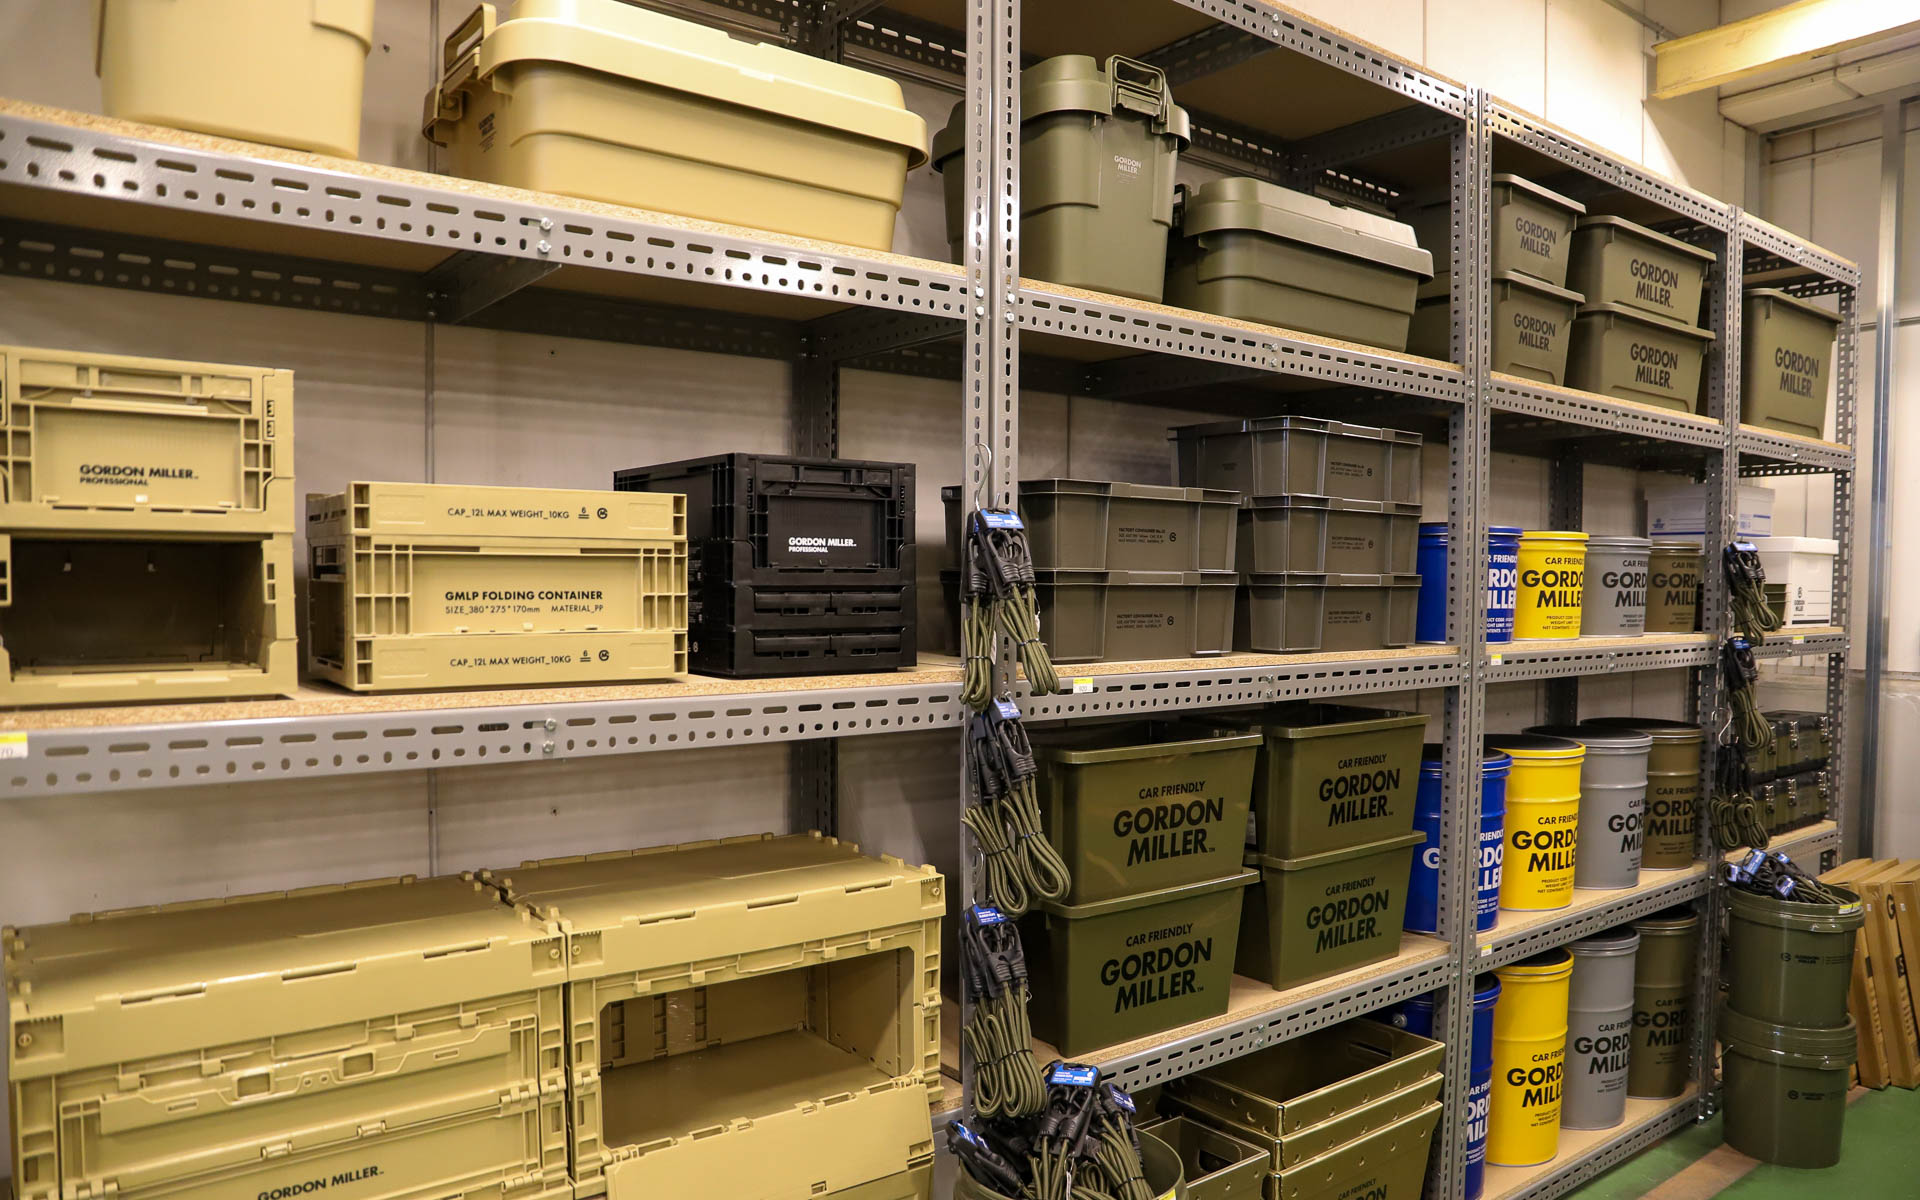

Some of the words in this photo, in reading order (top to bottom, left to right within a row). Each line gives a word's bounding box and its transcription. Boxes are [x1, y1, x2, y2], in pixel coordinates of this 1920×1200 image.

[1114, 155, 1141, 168] GORDON
[1118, 163, 1138, 174] MILLER
[1515, 216, 1557, 245] GORDON
[1520, 235, 1550, 259] MILLER
[1630, 258, 1679, 289] GORDON
[1514, 313, 1556, 337] GORDON
[1518, 330, 1550, 351] MILLER
[1630, 342, 1678, 370] GORDON
[1775, 347, 1819, 378] GORDON
[1780, 372, 1812, 398] MILLER
[80, 464, 144, 477] GORDON
[80, 477, 148, 486] PROFESSIONAL
[448, 508, 484, 518] CAP_12L
[510, 510, 569, 519] WEIGHT_10KG
[788, 537, 826, 546] GORDON
[1545, 557, 1562, 565] CAR
[1488, 568, 1517, 588] RDO
[1522, 569, 1583, 588] GORDO
[1602, 571, 1647, 588] GORD
[1652, 573, 1697, 588] GORD
[445, 591, 479, 600] GMLP
[482, 591, 534, 600] FOLDING
[538, 591, 603, 600] CONTAINER
[1487, 590, 1516, 609] ILLE
[1537, 590, 1581, 608] MILLE
[1615, 590, 1647, 607] MILL
[1664, 590, 1695, 606] MILL
[552, 605, 604, 613] MATERIAL_PP
[450, 658, 486, 668] CAP_12L
[490, 657, 509, 665] MAX
[512, 655, 571, 665] WEIGHT_10KG
[1338, 759, 1353, 769] CAR
[1354, 754, 1387, 767] FRIENDLY
[1139, 786, 1159, 799] CAR
[1161, 781, 1206, 797] FRIENDLY
[1319, 769, 1400, 802] GORDON
[1656, 787, 1673, 795] CAR
[1113, 797, 1224, 837] GORDON
[1328, 795, 1388, 827] MILLER
[1538, 816, 1556, 824] CAR
[1608, 812, 1643, 832] GOR
[1647, 818, 1695, 836] MILLE
[1127, 829, 1208, 866] MILLER
[1528, 849, 1575, 872] MILLE
[1326, 884, 1340, 896] CAR
[1342, 877, 1376, 893] FRIENDLY
[1306, 889, 1389, 929] GORDON
[1126, 934, 1146, 947] CAR
[1148, 923, 1193, 942] FRIENDLY
[1316, 917, 1377, 953] MILLER
[1101, 938, 1212, 986] GORDON
[1115, 969, 1196, 1014] MILLER
[1633, 1010, 1687, 1028] GORD
[1574, 1033, 1630, 1054] GORD
[1647, 1028, 1684, 1047] MILL
[1532, 1053, 1549, 1062] CAR
[1589, 1052, 1627, 1074] MILL
[1507, 1062, 1562, 1087] GORD
[1469, 1086, 1480, 1096] AR
[1522, 1083, 1560, 1107] MILL
[258, 1178, 326, 1200] GORDON
[331, 1166, 378, 1186] MILLER
